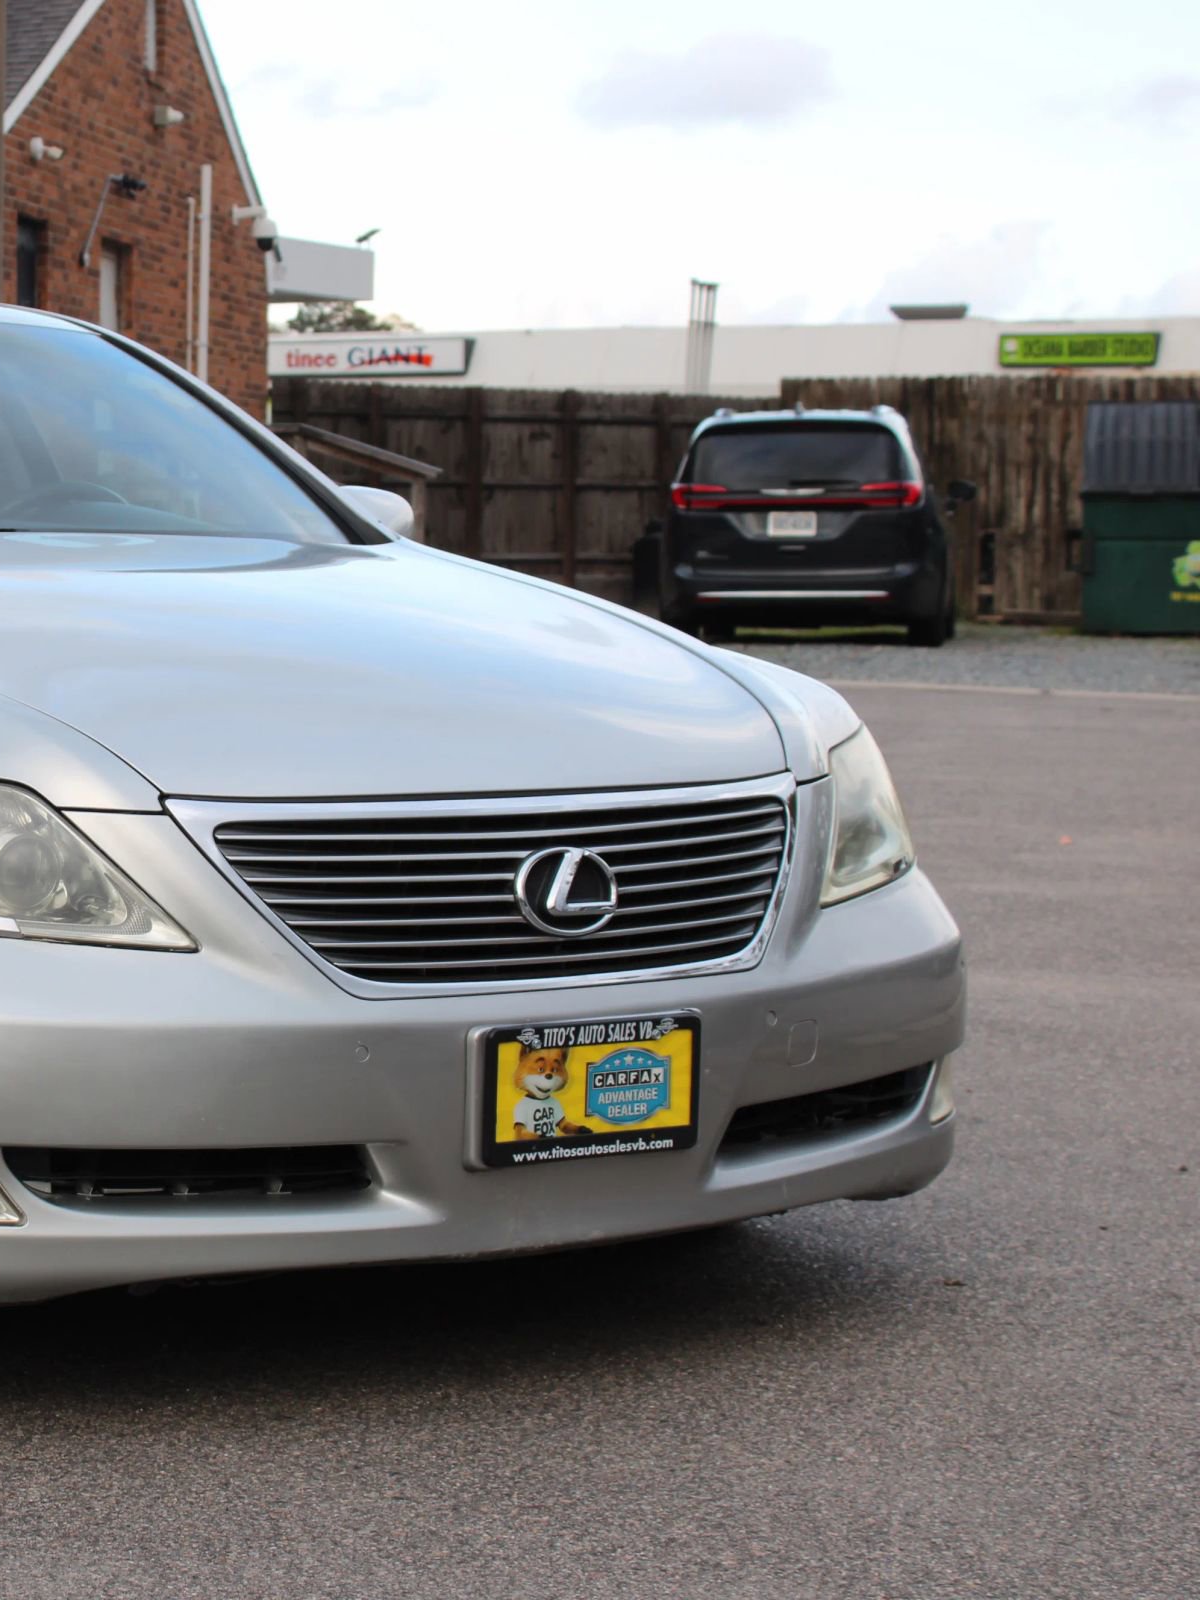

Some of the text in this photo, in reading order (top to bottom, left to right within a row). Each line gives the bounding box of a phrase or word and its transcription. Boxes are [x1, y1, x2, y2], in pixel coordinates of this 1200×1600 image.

[347, 345, 428, 367] GIANT
[543, 1021, 654, 1048] TITO'S AUTO SALES VB
[594, 1069, 663, 1087] CARFAX
[598, 1088, 658, 1104] ADVANTAGE
[533, 1107, 555, 1122] CAR
[607, 1102, 647, 1118] DEALER
[534, 1120, 556, 1134] FOX
[512, 1137, 674, 1163] www.titosautosalesvb.com
